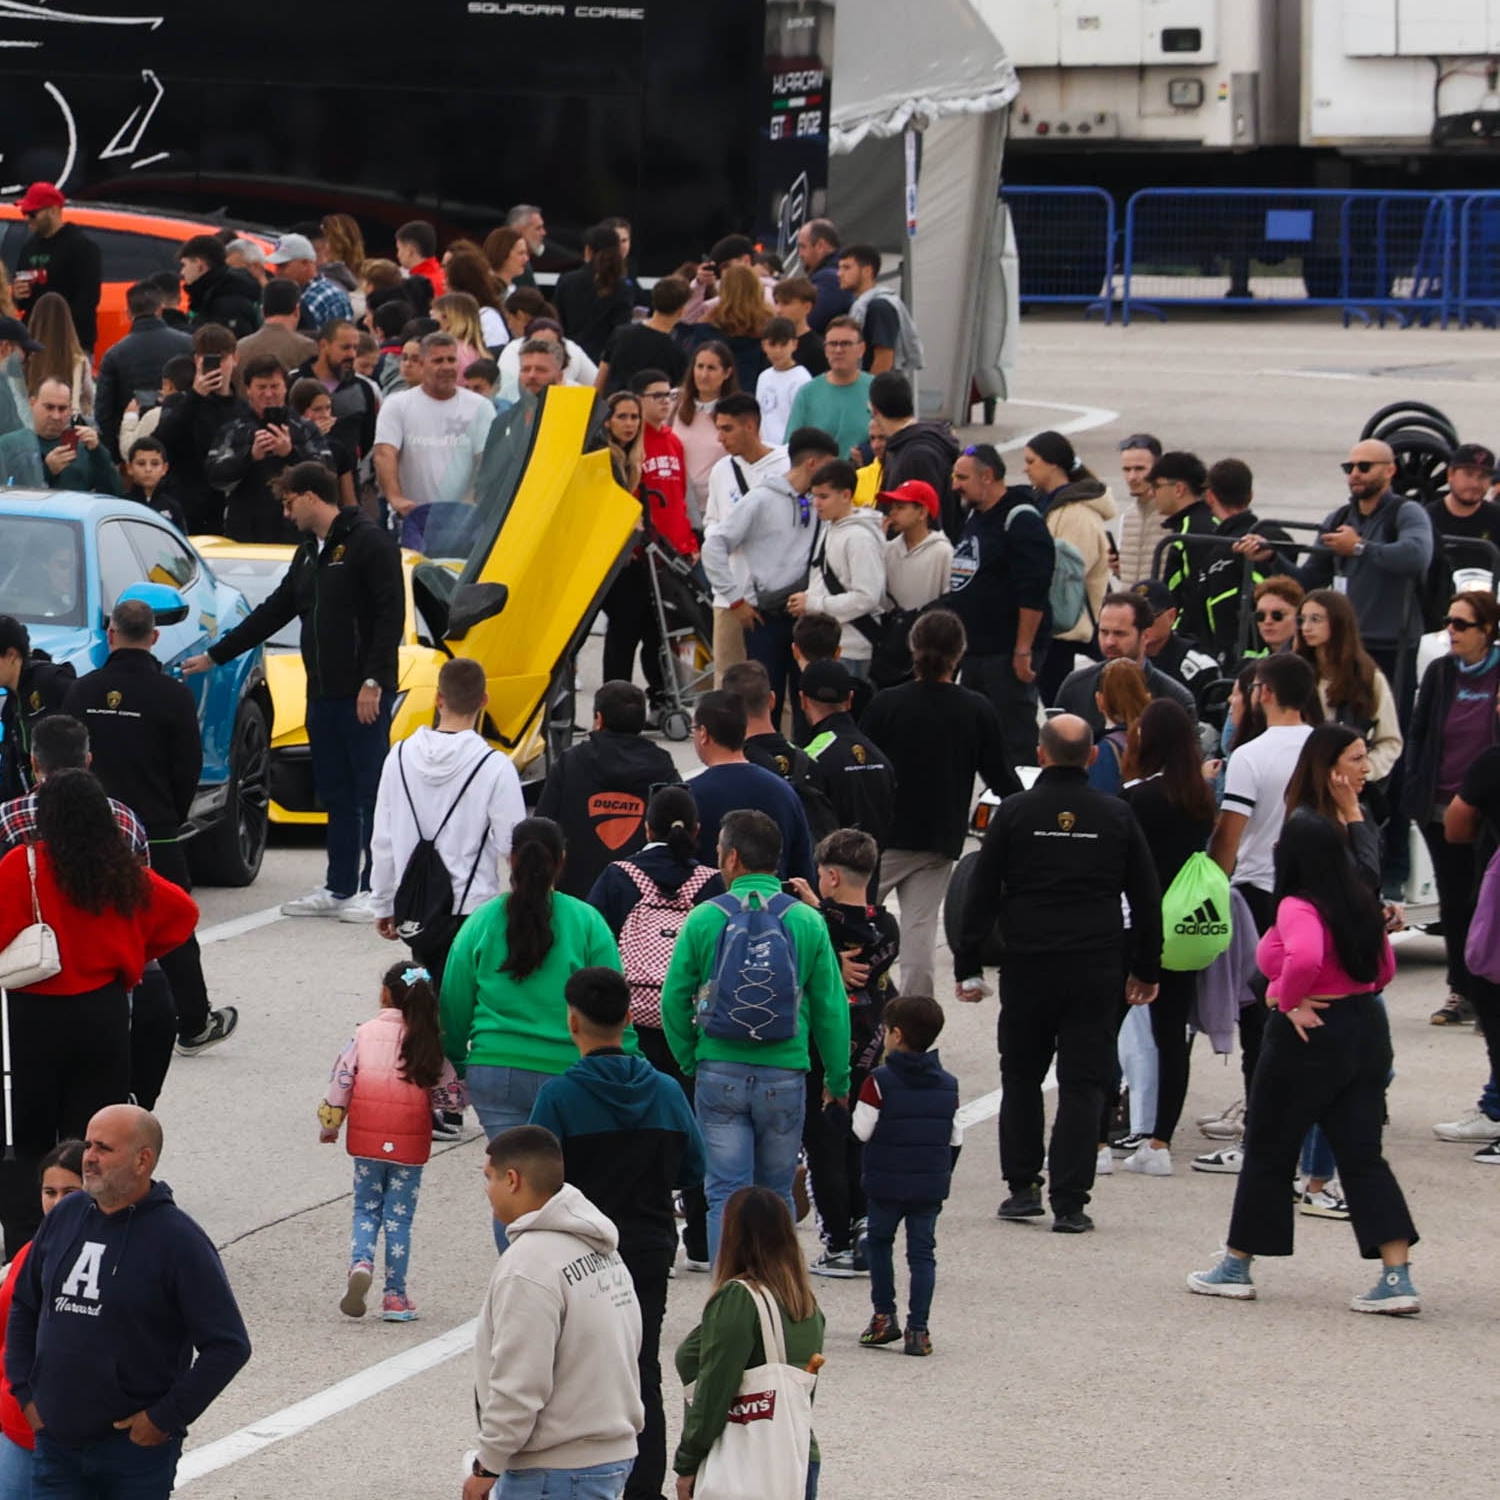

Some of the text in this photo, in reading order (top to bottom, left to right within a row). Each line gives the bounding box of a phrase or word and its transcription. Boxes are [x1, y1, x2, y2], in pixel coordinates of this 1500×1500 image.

[467, 2, 646, 20] SQUADRA CORSE
[592, 799, 641, 812] DUCATI
[1174, 922, 1229, 936] adidas
[62, 1241, 107, 1300] A
